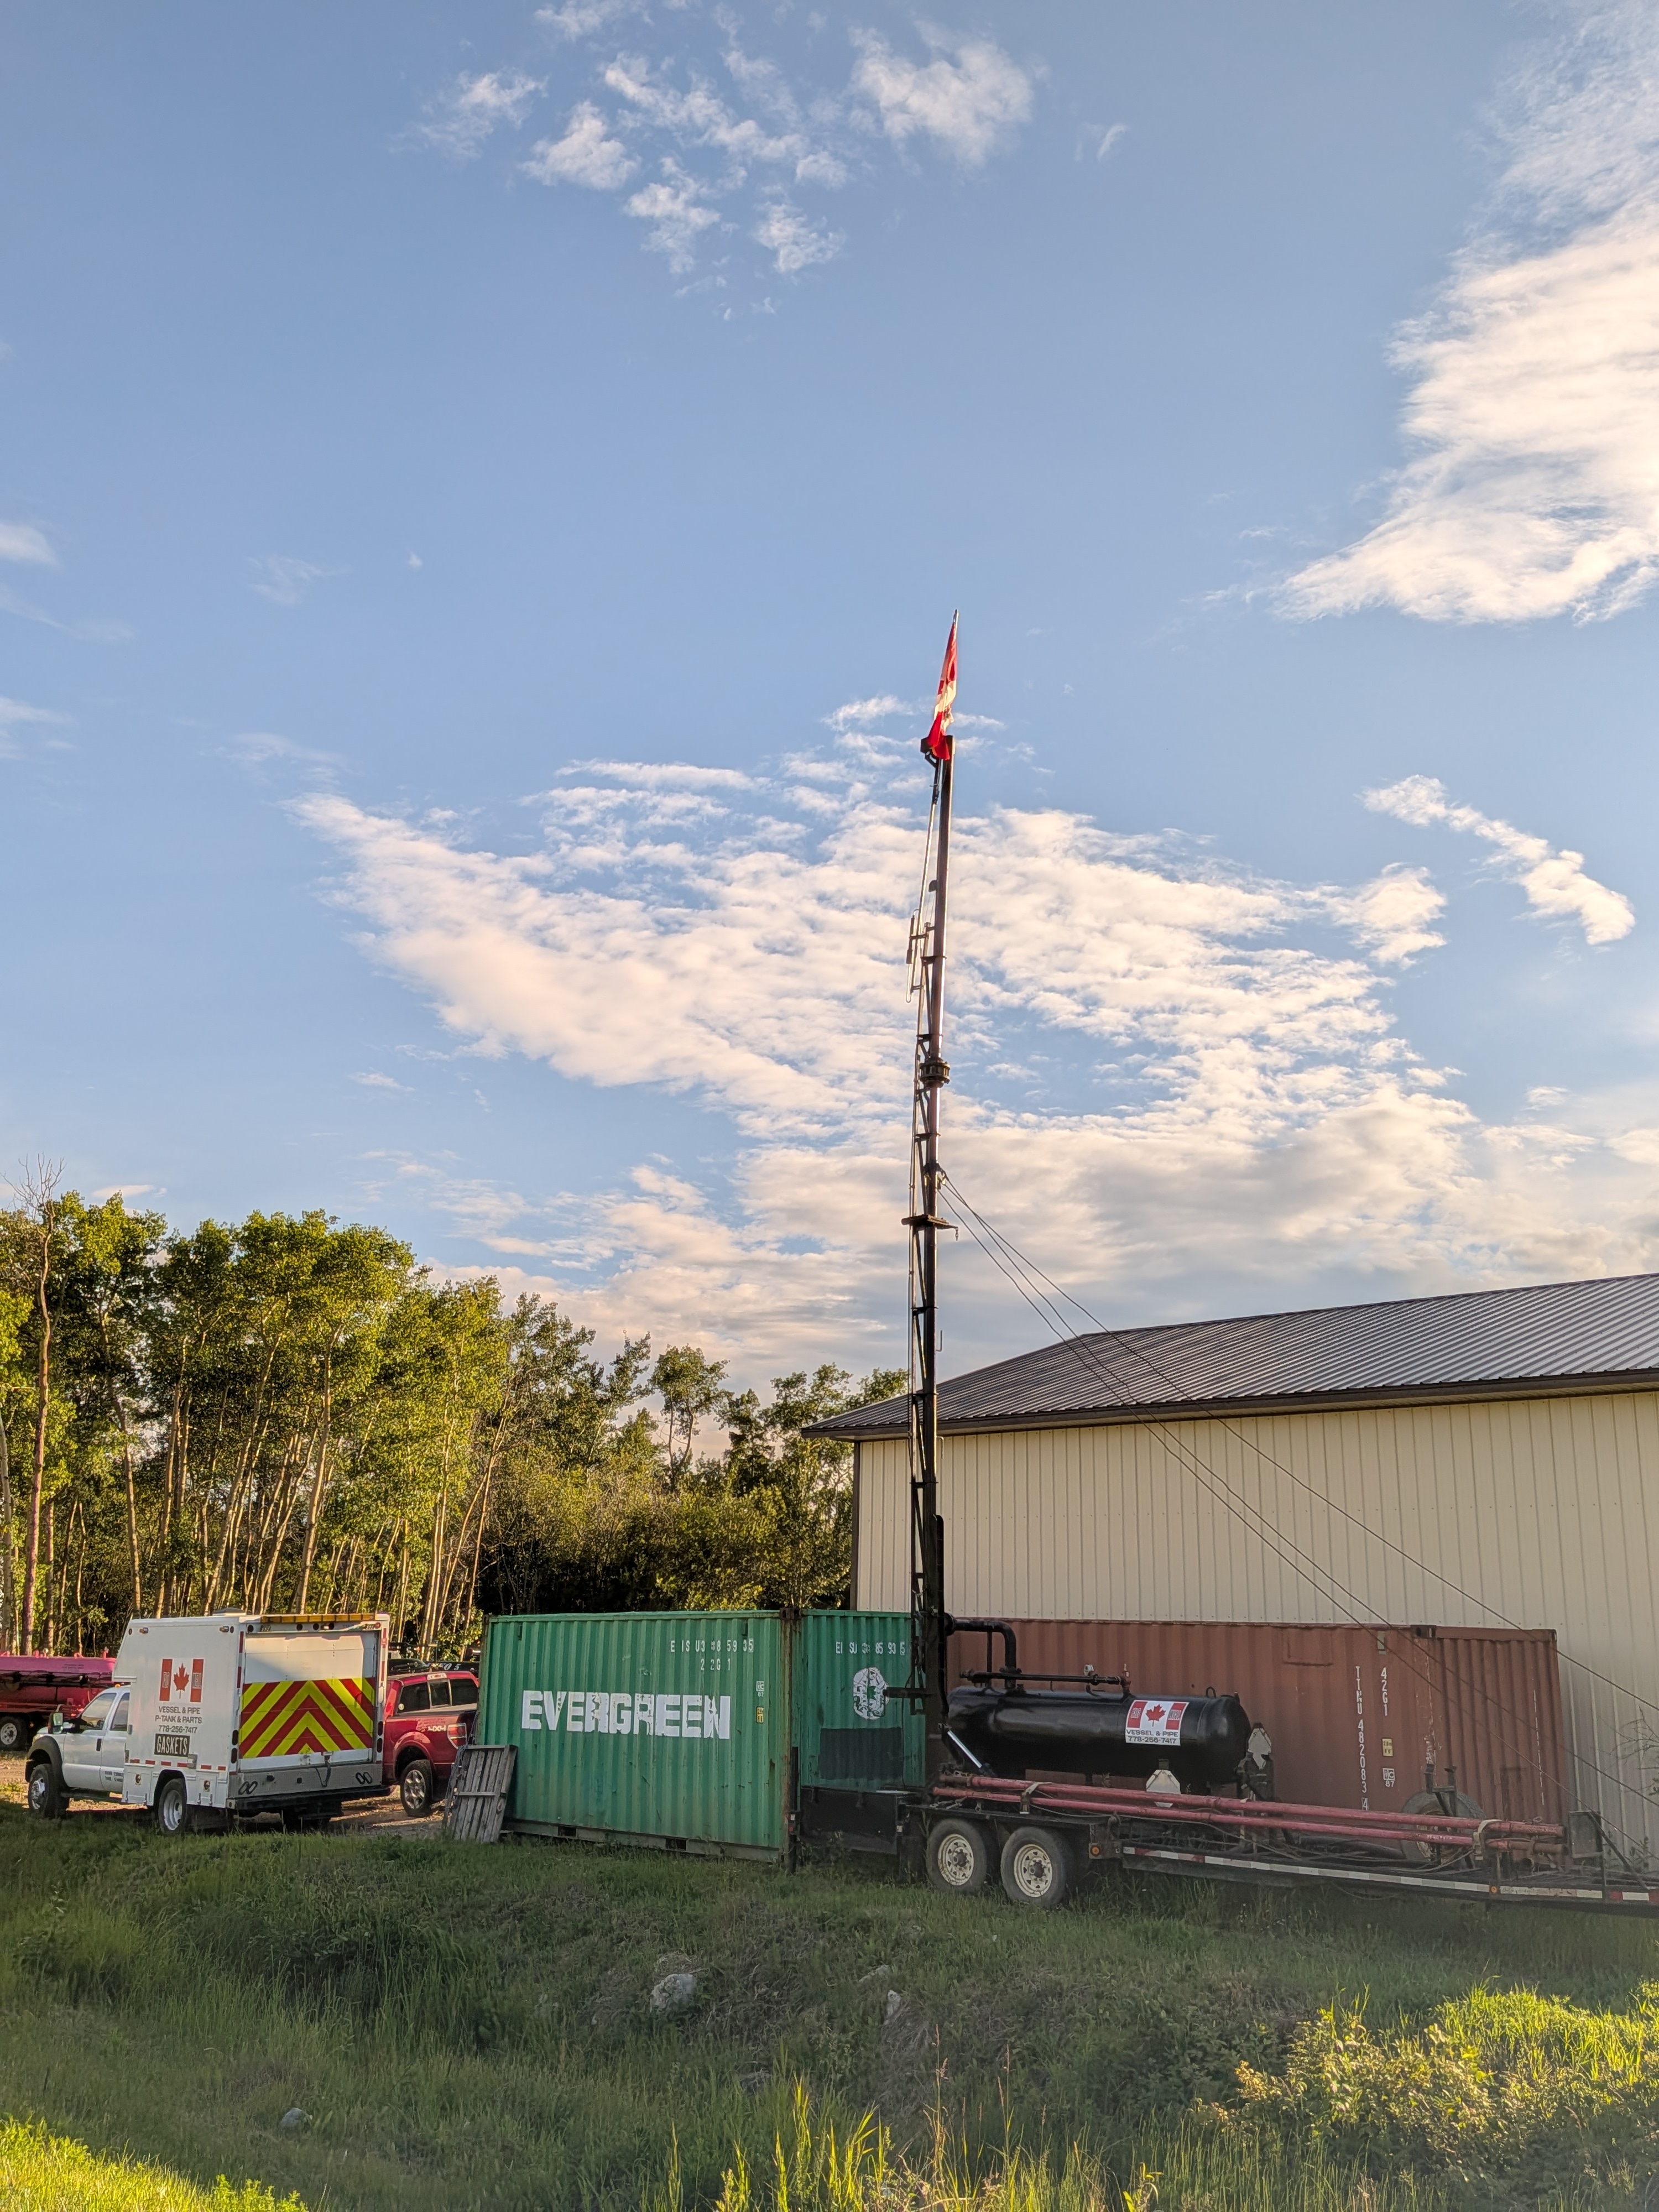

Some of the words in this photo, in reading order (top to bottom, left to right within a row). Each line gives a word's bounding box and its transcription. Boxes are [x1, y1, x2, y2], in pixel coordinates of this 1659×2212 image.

[521, 1690, 731, 1739] EVERGREEN
[158, 1725, 198, 1734] 778-256-7417
[156, 1735, 188, 1755] GASKETS
